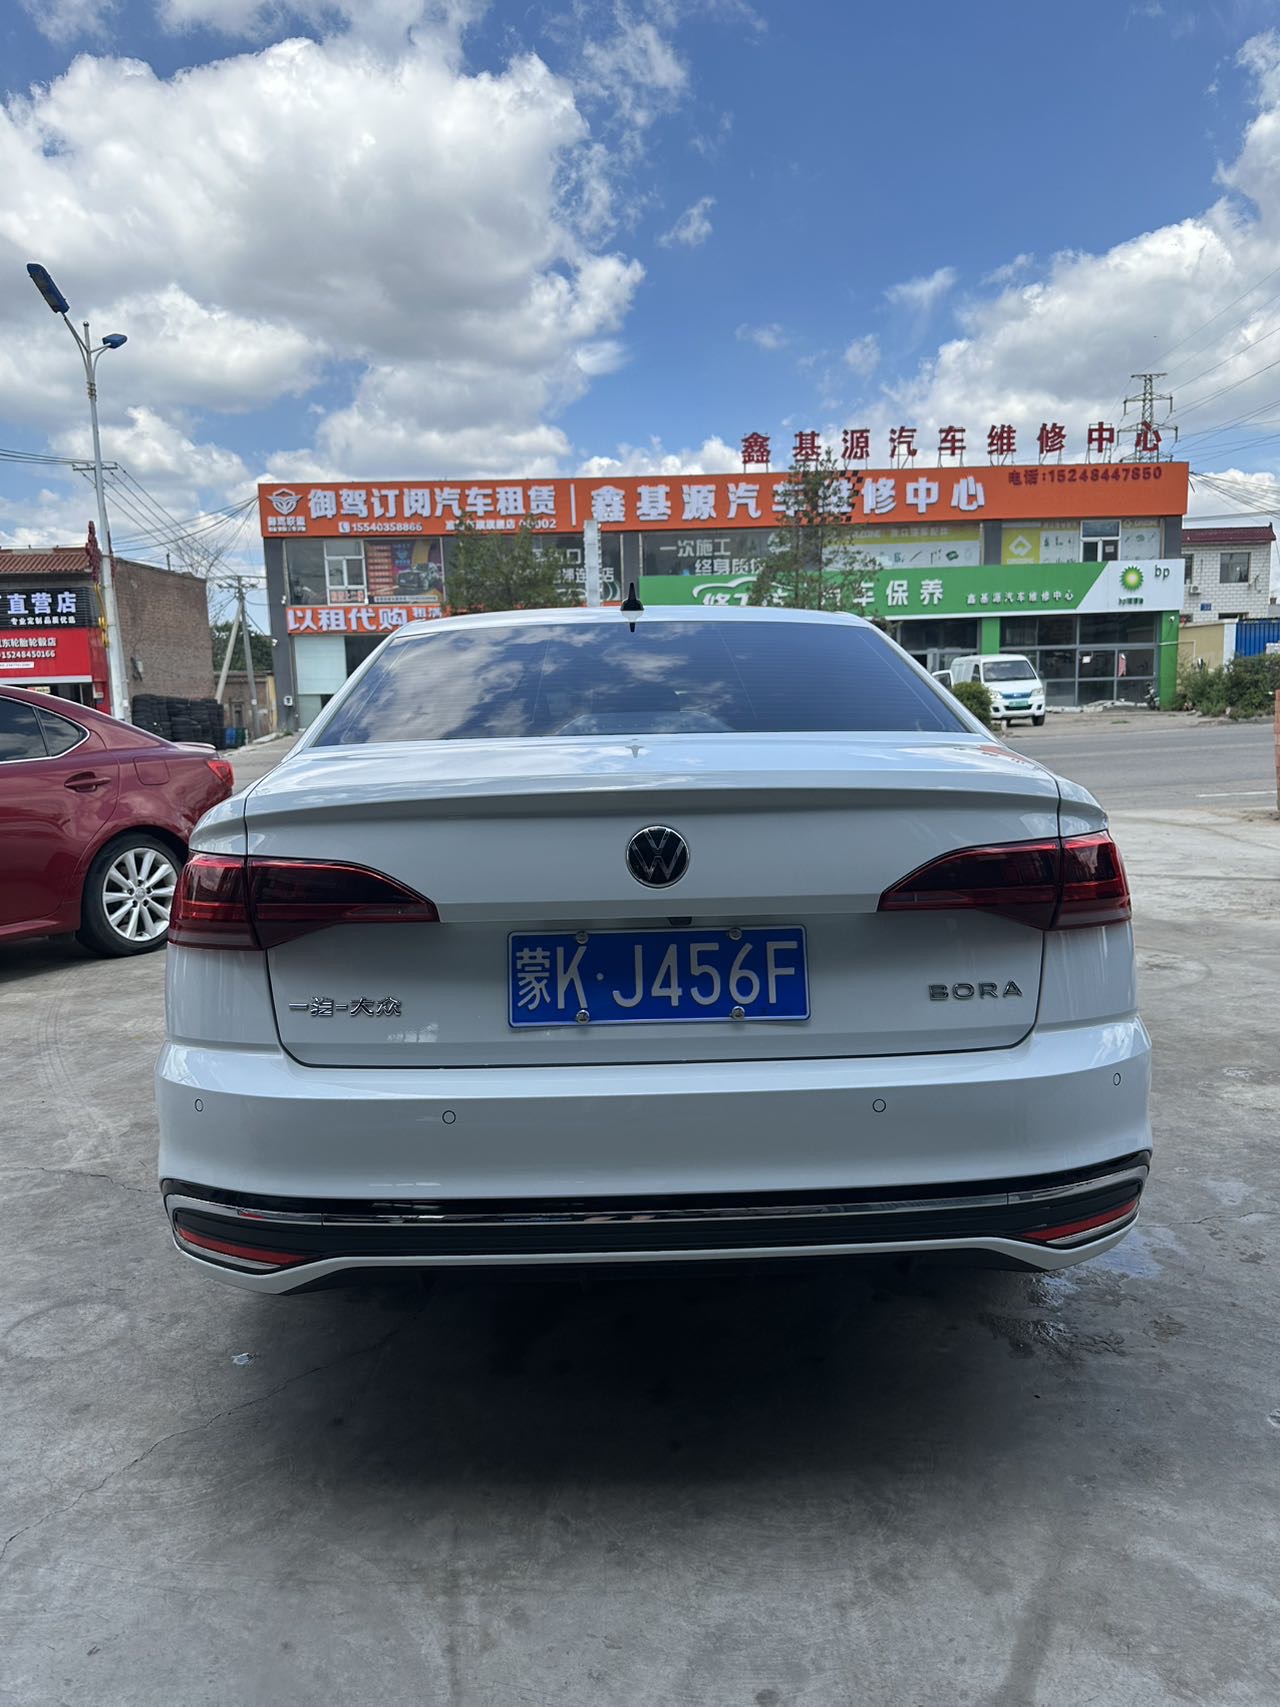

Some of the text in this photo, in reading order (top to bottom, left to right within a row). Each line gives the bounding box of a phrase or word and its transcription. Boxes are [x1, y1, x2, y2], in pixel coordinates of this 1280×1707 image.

[741, 421, 1162, 464] 鑫基源汽车维修中心
[591, 476, 985, 523] 鑫基源汽车维修中心
[660, 538, 731, 557] 一次施工
[1155, 565, 1170, 580] bp
[287, 607, 408, 631] 以租代购
[928, 980, 1023, 1001] BORA
